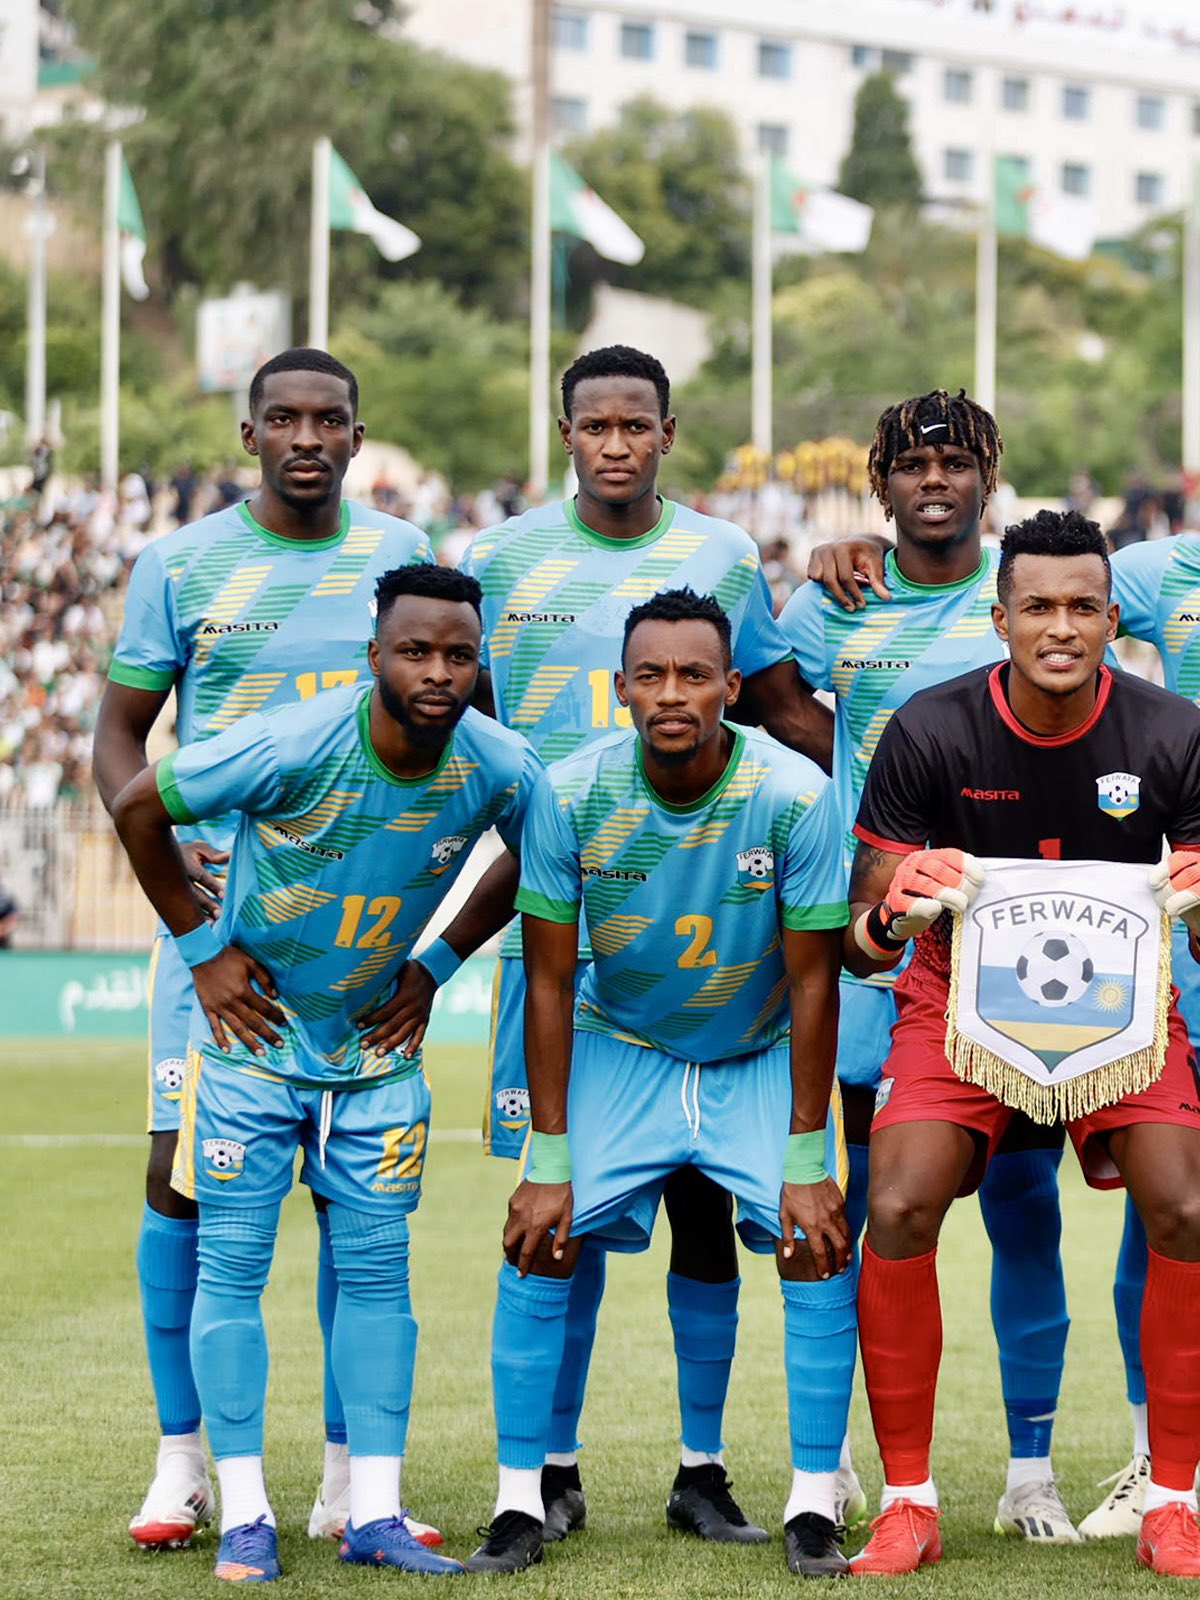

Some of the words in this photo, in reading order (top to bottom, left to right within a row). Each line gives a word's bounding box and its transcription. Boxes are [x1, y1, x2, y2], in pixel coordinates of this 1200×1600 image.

[334, 894, 402, 949] 12
[674, 914, 718, 969] 2
[992, 899, 1129, 940] FERWAFA
[376, 1121, 426, 1179] 12
